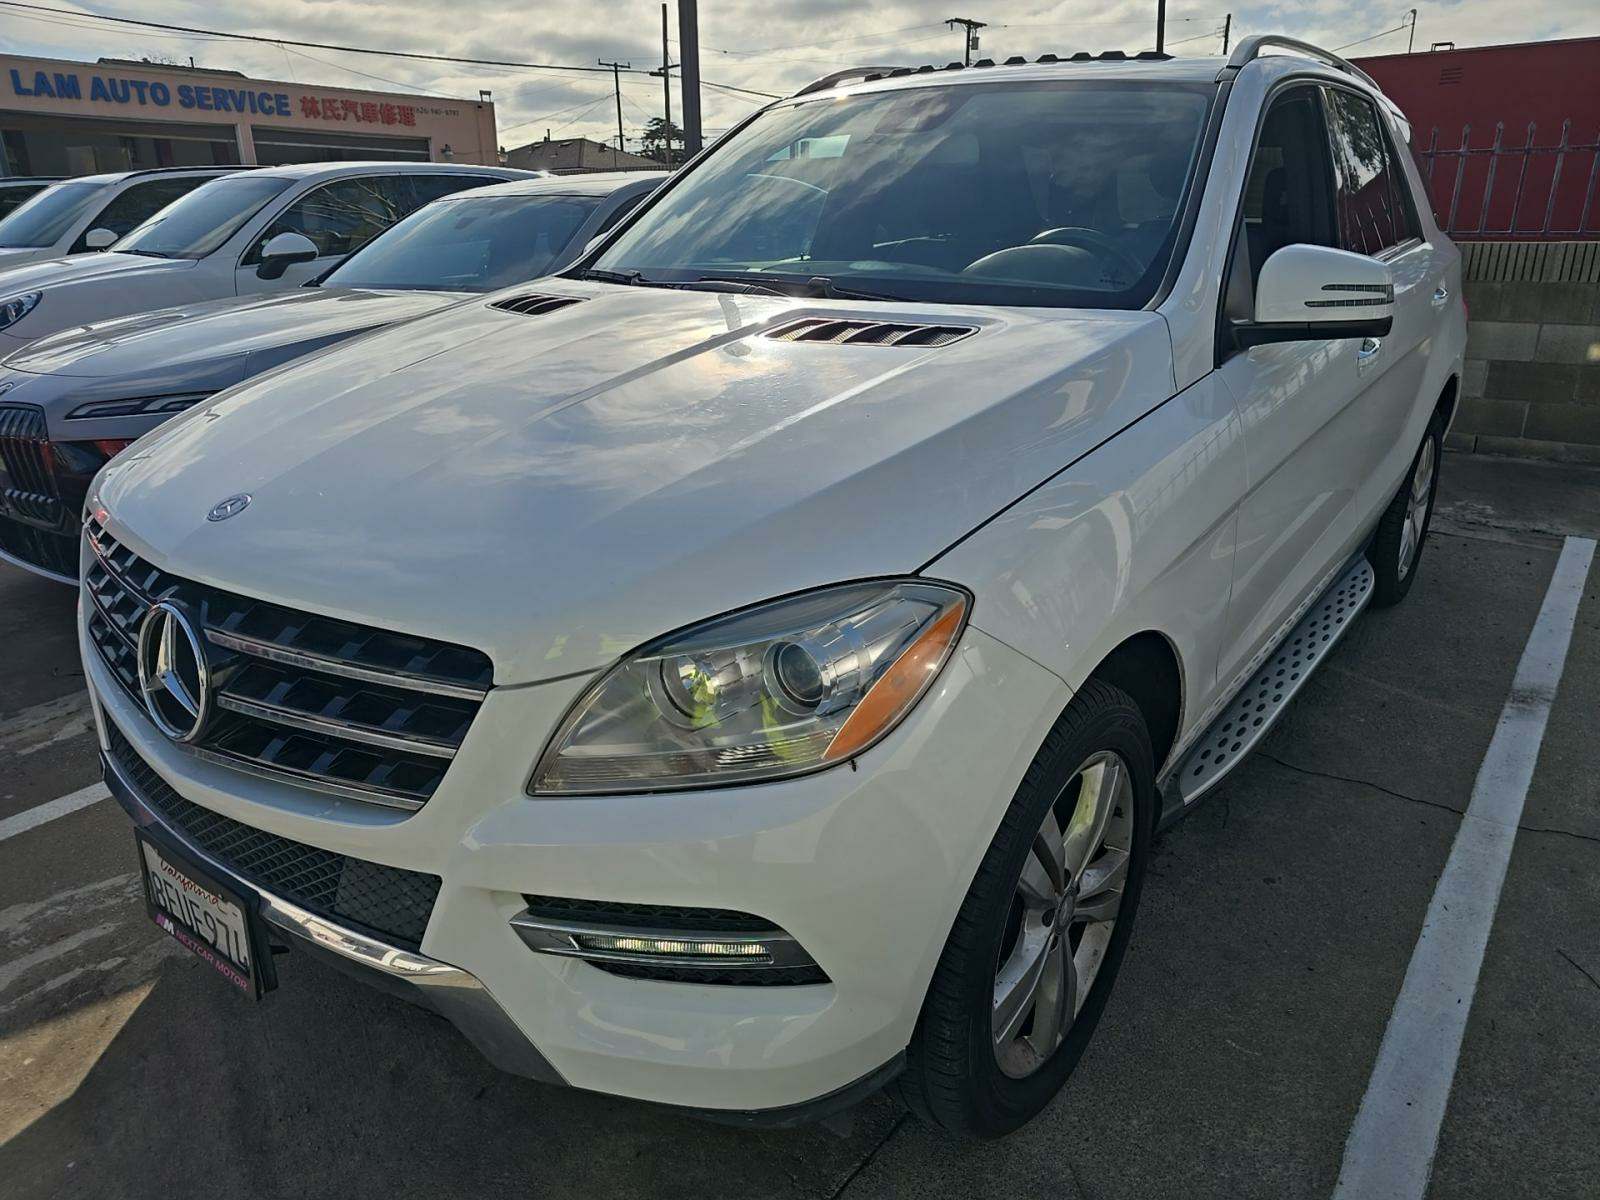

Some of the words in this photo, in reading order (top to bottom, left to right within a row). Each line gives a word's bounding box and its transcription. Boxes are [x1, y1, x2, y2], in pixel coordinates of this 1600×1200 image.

[9, 69, 82, 99] LAM
[90, 76, 171, 107] AUTO
[177, 84, 292, 116] SERVICE
[299, 96, 416, 127] 林氏汽車修理
[214, 960, 248, 992] MOTOR
